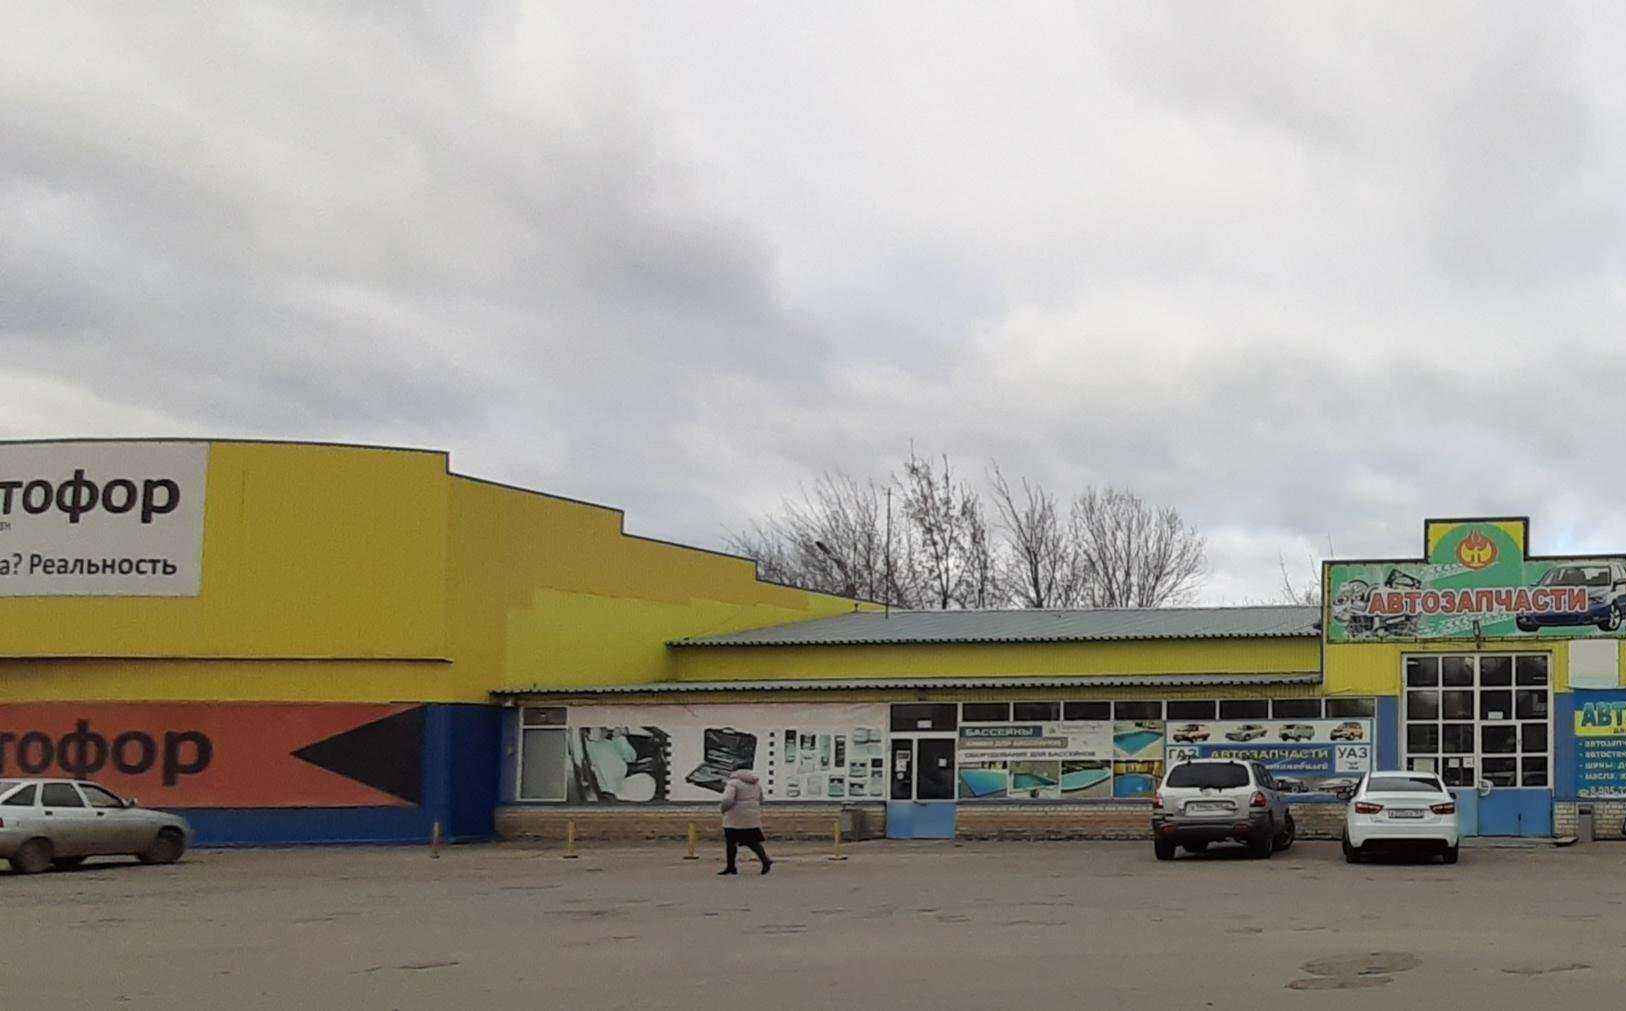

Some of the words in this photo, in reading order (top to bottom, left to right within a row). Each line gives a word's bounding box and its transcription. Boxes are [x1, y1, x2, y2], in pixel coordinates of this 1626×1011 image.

[30, 553, 177, 576] Реальность
[1367, 586, 1589, 616] АВТОЗАПЧАСТИ
[1168, 748, 1199, 760] ГАЗ
[1211, 748, 1329, 760] АВТОЗАПЧАСТИ
[1337, 746, 1368, 759] УАЗ
